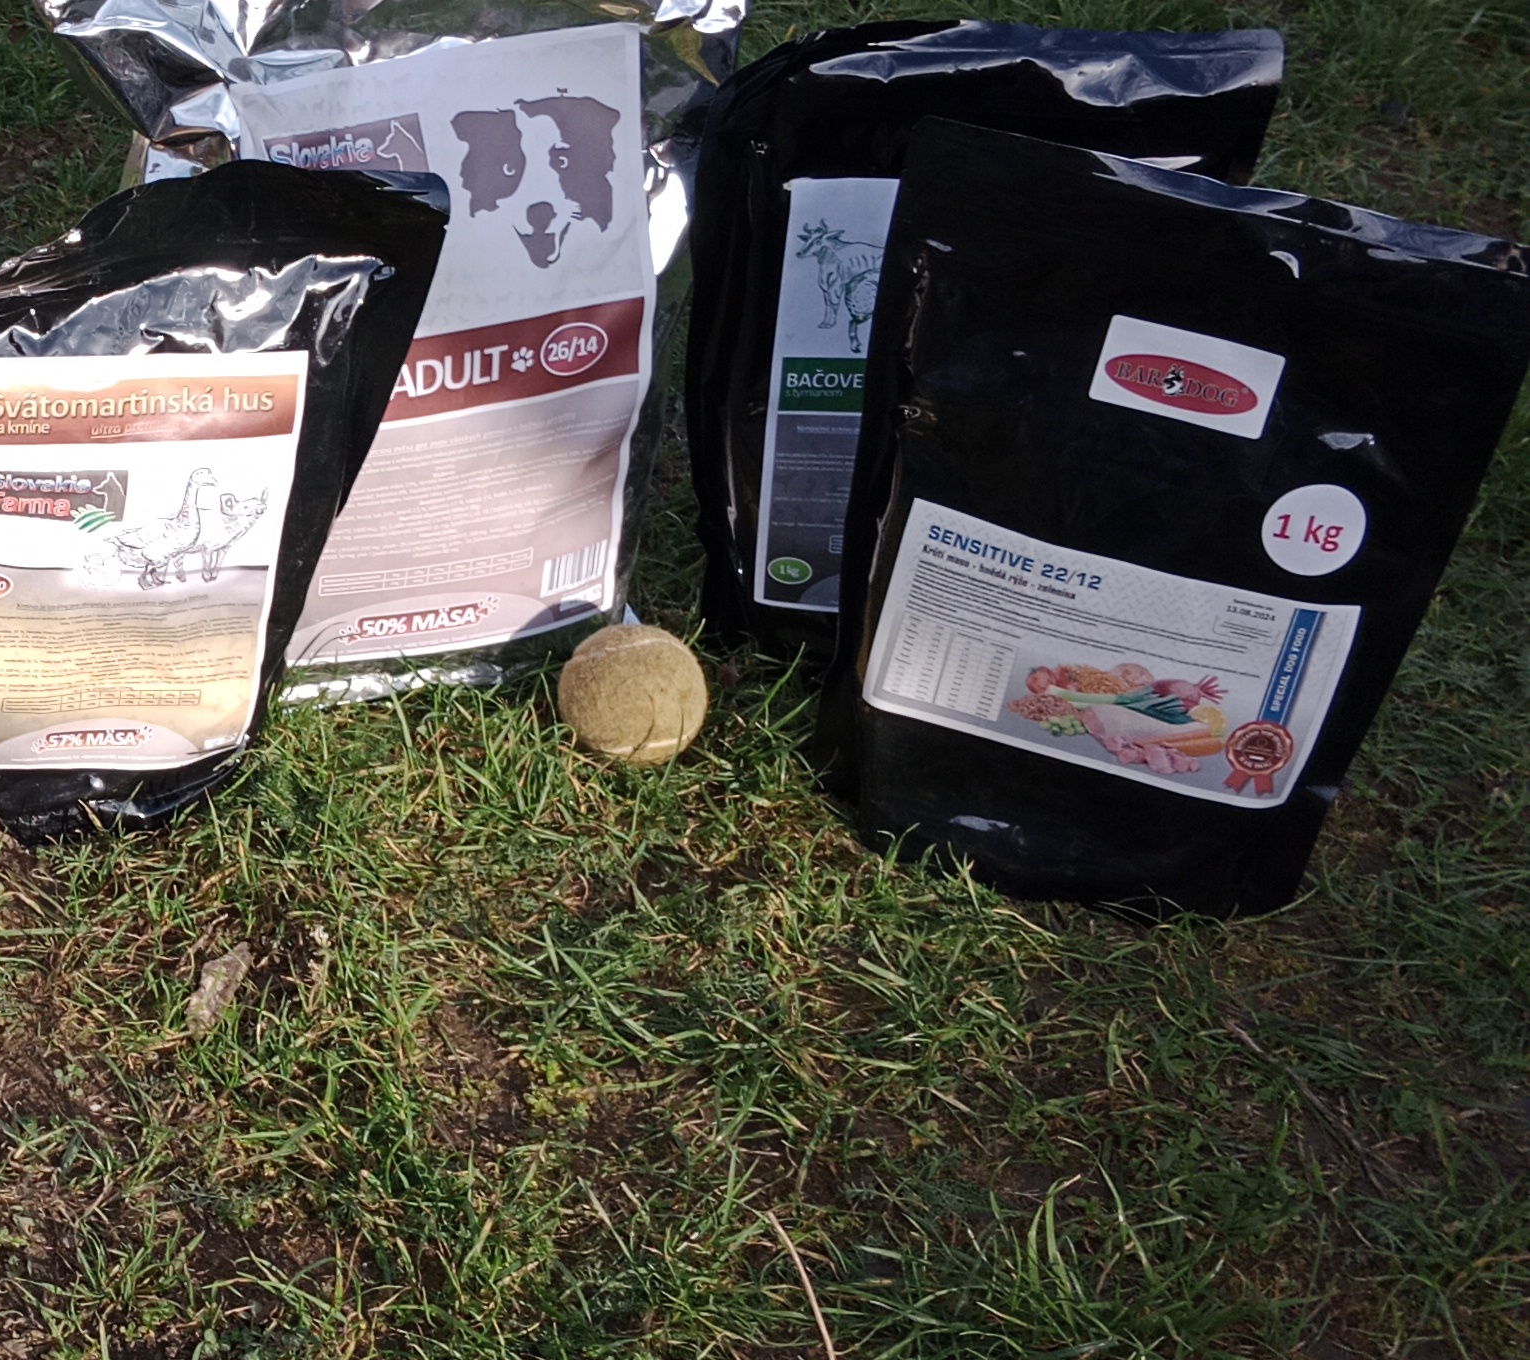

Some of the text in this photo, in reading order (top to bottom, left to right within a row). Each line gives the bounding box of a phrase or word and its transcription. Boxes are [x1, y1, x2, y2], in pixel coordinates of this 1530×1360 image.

[271, 133, 374, 169] Slovakia
[390, 336, 598, 400] ADULT 26/14
[786, 369, 864, 389] BAČOVE
[1117, 362, 1239, 408] BAR DOG
[223, 386, 274, 413] hus
[1272, 513, 1343, 552] 1 kg
[928, 525, 1102, 590] SENSITIVE 22/12
[361, 607, 477, 637] 50% MÄSA
[1270, 674, 1291, 713] SPECIAL
[47, 728, 137, 749] 57% MÄSA
